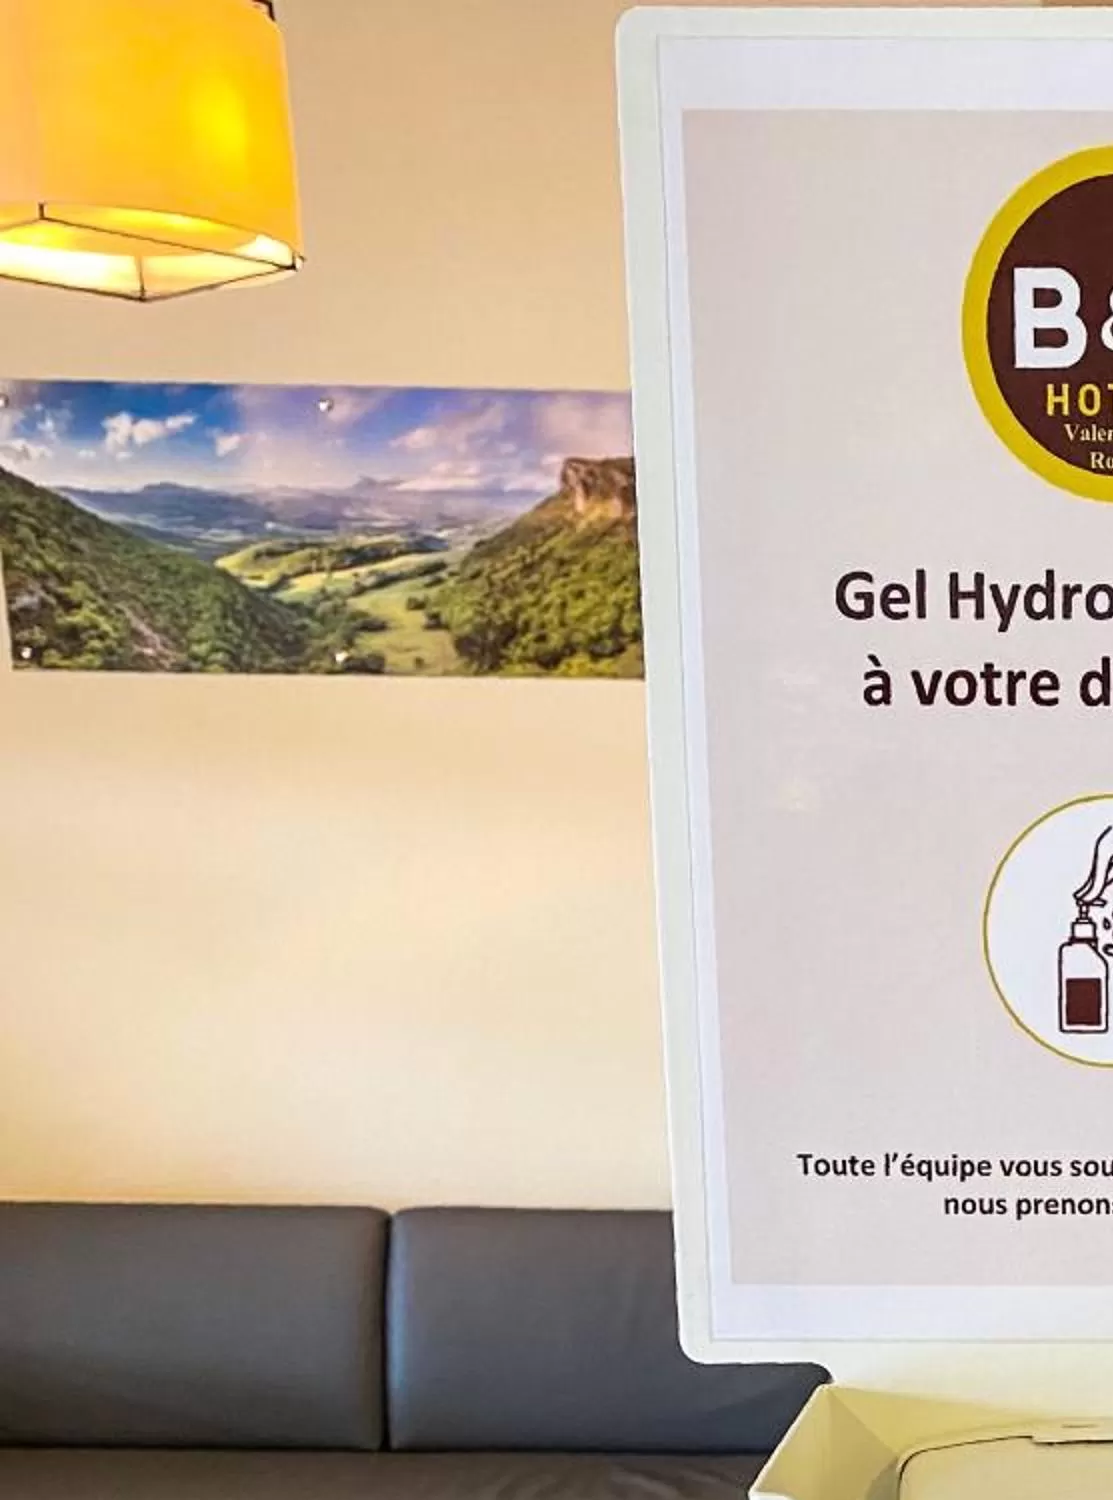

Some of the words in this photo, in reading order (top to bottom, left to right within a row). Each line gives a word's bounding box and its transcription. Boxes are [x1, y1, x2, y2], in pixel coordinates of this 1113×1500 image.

[836, 569, 926, 620] Gel
[864, 655, 891, 706] à
[911, 663, 1060, 706] votre
[797, 1154, 874, 1176] Toute
[885, 1153, 992, 1182] l’équipe
[1000, 1160, 1062, 1176] vous
[945, 1198, 1007, 1214] nous
